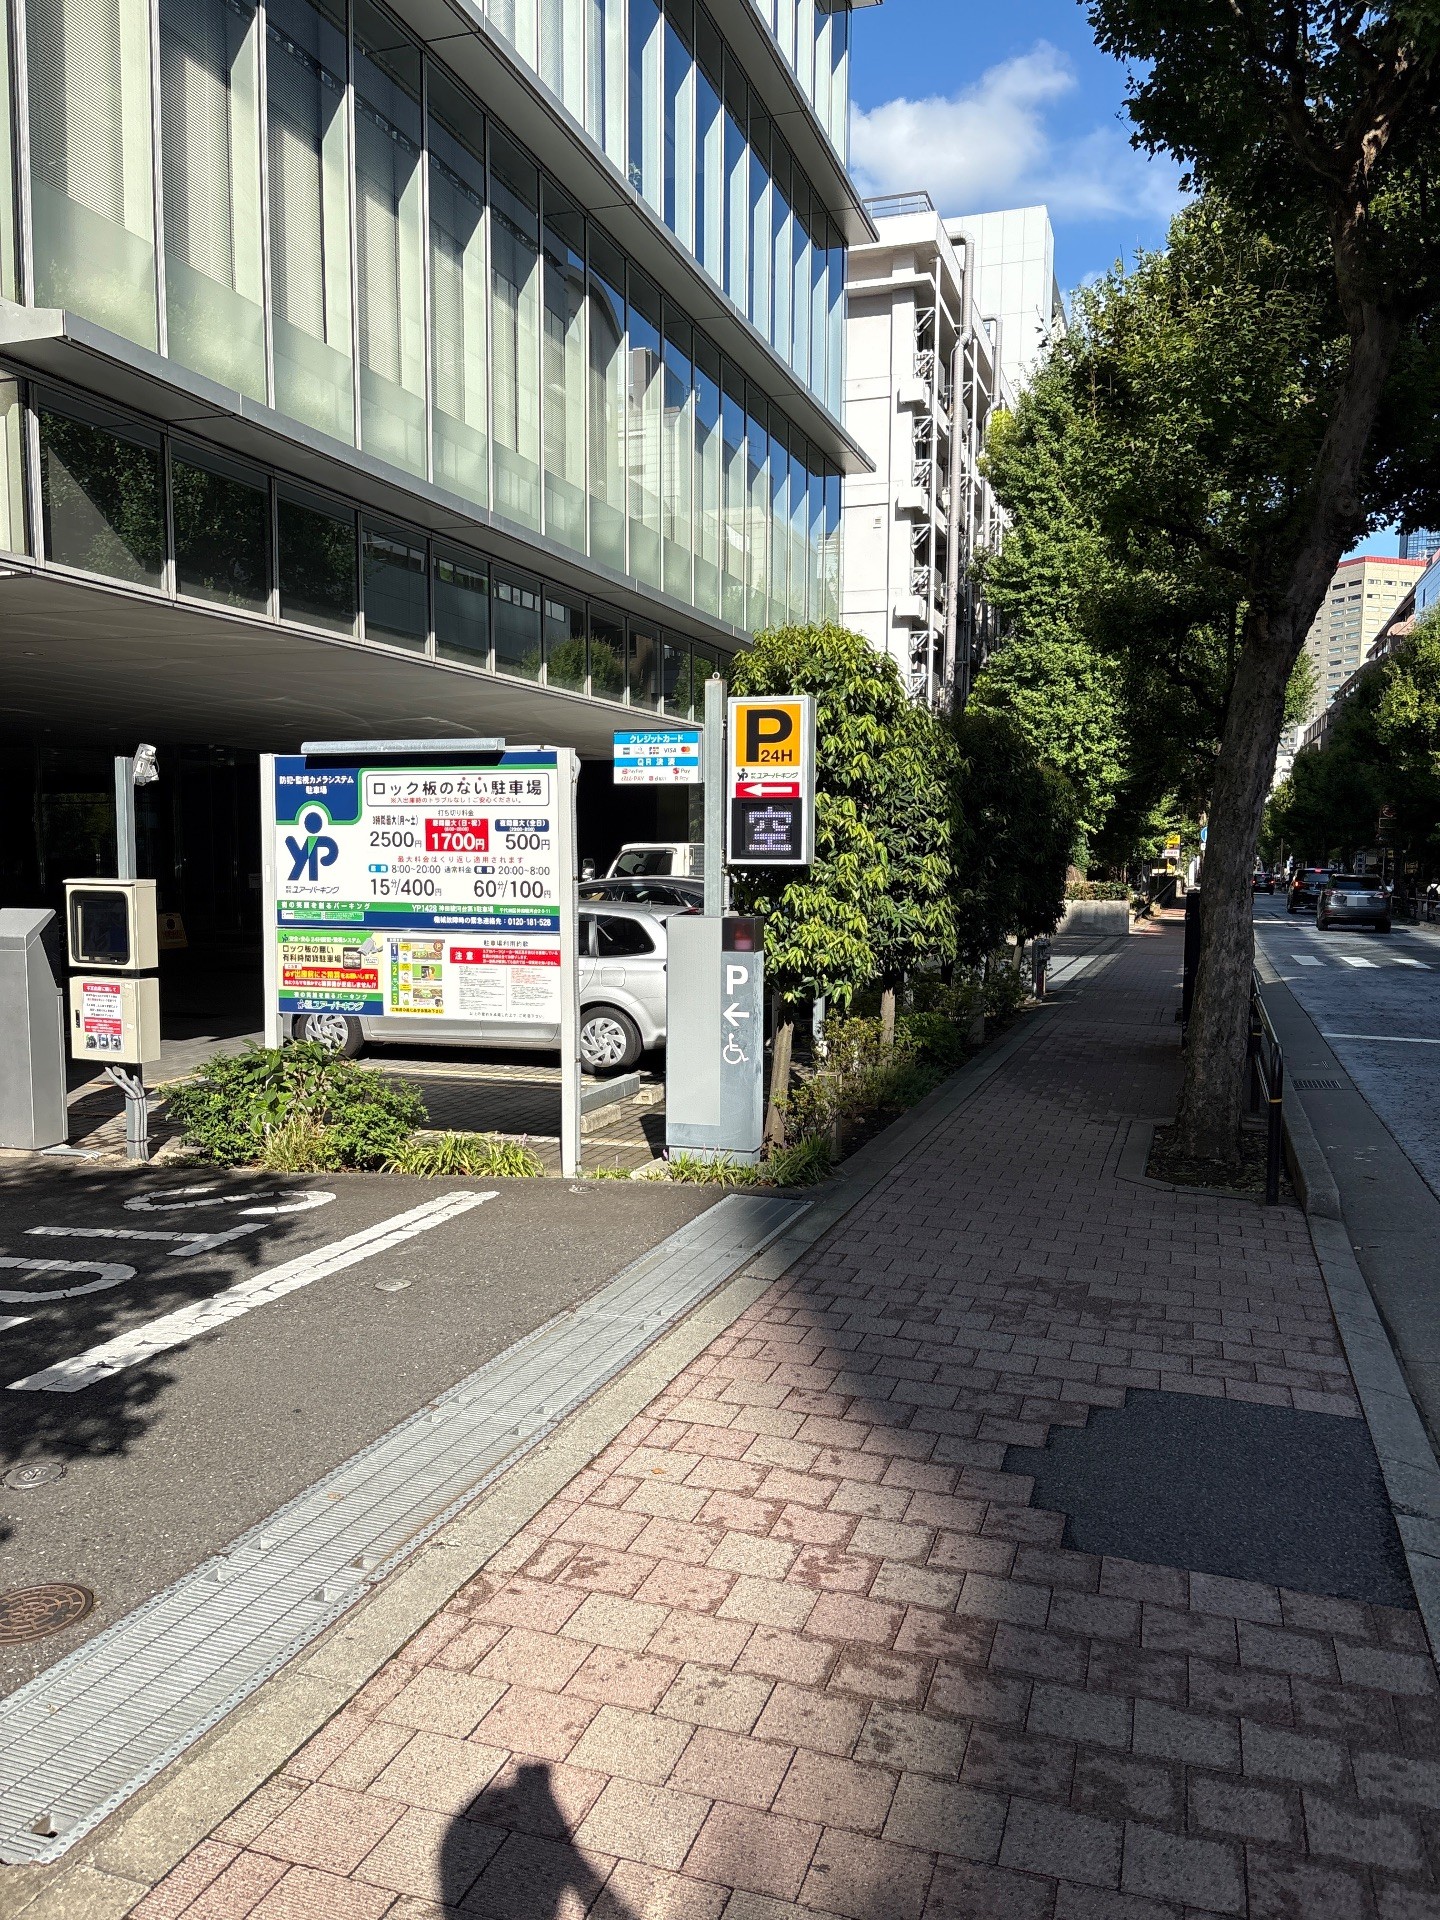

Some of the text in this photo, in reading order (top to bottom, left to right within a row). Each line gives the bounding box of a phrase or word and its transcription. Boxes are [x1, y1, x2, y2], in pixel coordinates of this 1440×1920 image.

[629, 734, 684, 743] クレジットカード
[746, 709, 793, 762] P
[760, 749, 793, 763] 24H
[373, 778, 542, 796] ロック板のない駐車場
[437, 809, 474, 817] 打ち切り料金
[748, 806, 792, 851] 空
[370, 830, 422, 849] 2500円
[431, 832, 486, 850] 1700円
[505, 833, 551, 851] 500円
[397, 855, 524, 864] 最大料金はくり返し適用されます
[444, 866, 472, 874] 通常料金
[454, 951, 474, 961] 注意
[726, 964, 749, 996] P
